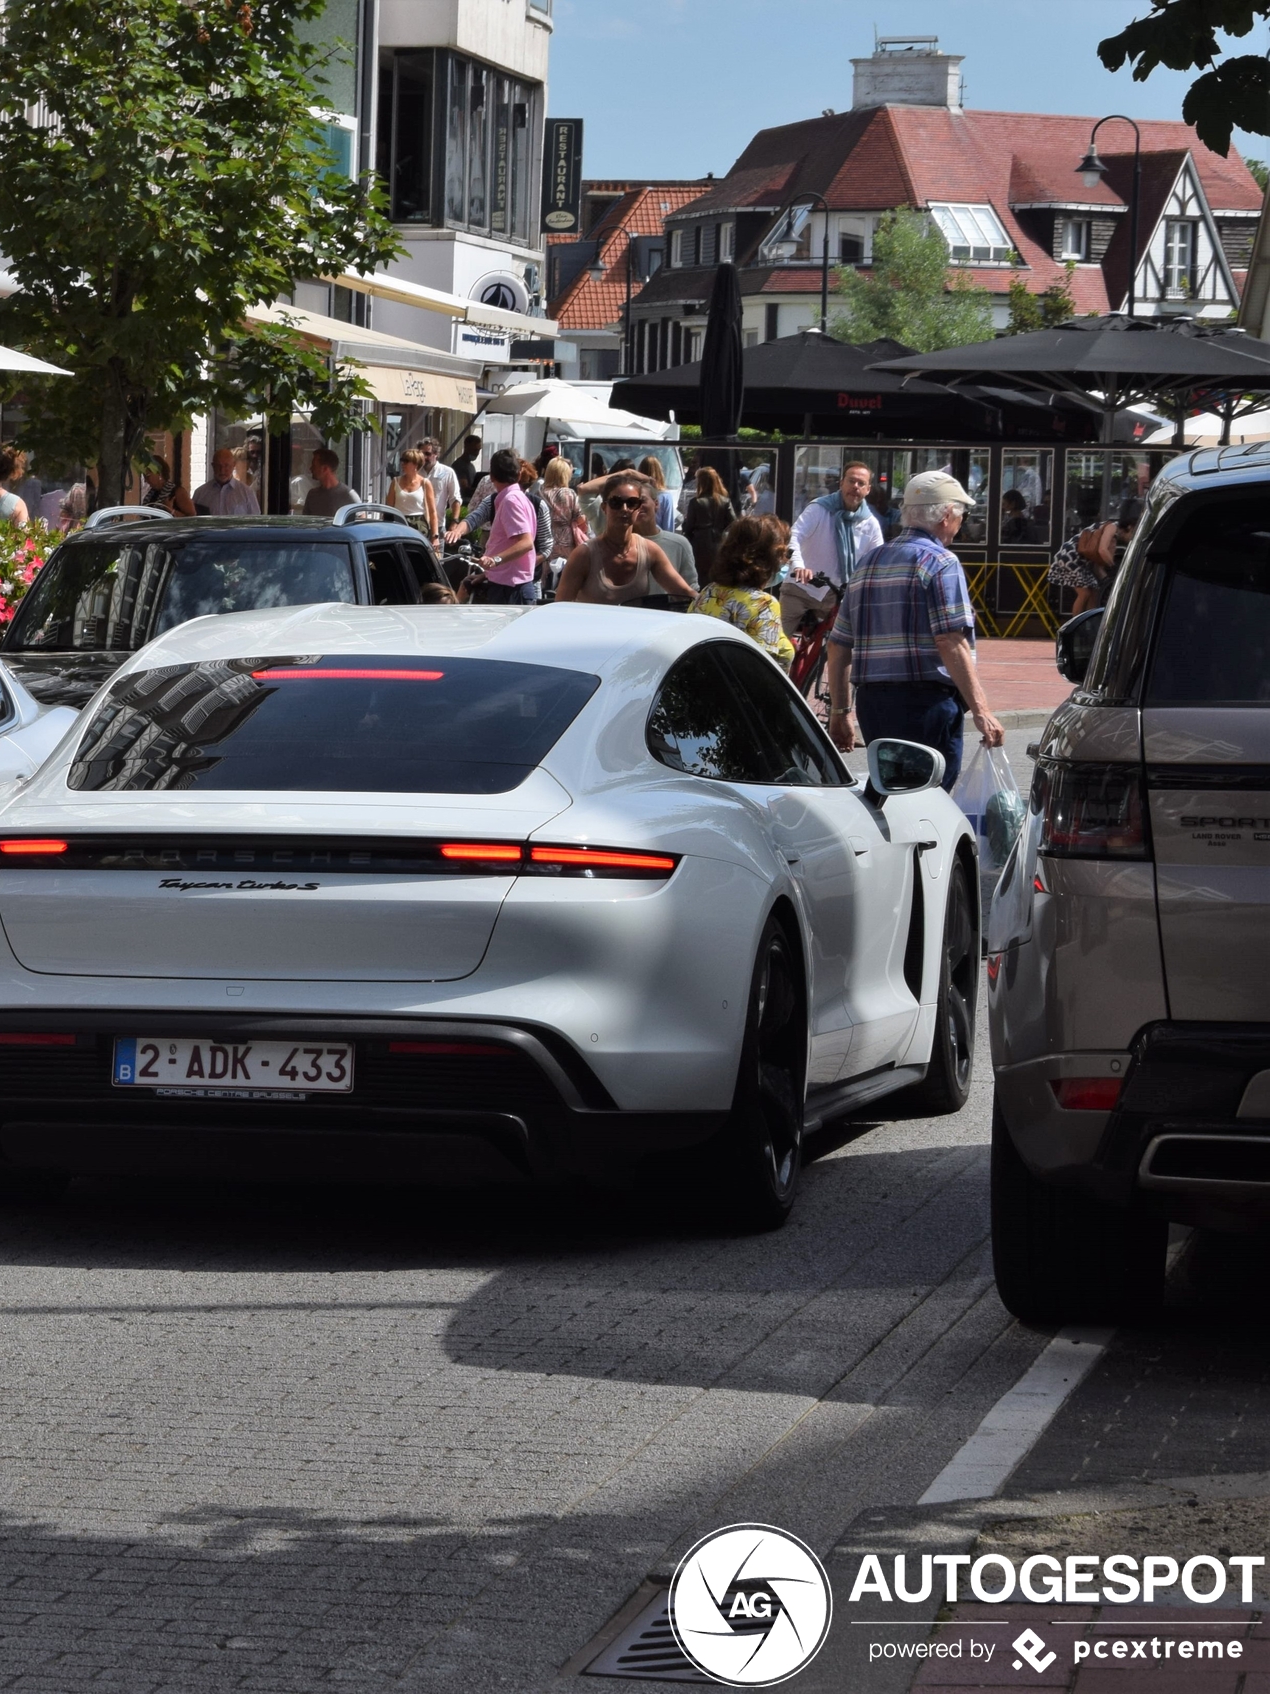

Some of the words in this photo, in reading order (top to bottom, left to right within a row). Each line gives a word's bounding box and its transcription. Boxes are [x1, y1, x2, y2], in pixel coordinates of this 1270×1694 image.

[556, 126, 568, 208] RESTAURANT
[837, 393, 882, 409] Duvel
[123, 850, 372, 866] PORSCHE
[158, 878, 233, 891] Taycan
[297, 882, 321, 891] S
[119, 1065, 131, 1080] B
[157, 1088, 205, 1097] PORSCHE
[208, 1090, 250, 1098] CENTRE
[253, 1092, 306, 1101] BRUSSELS
